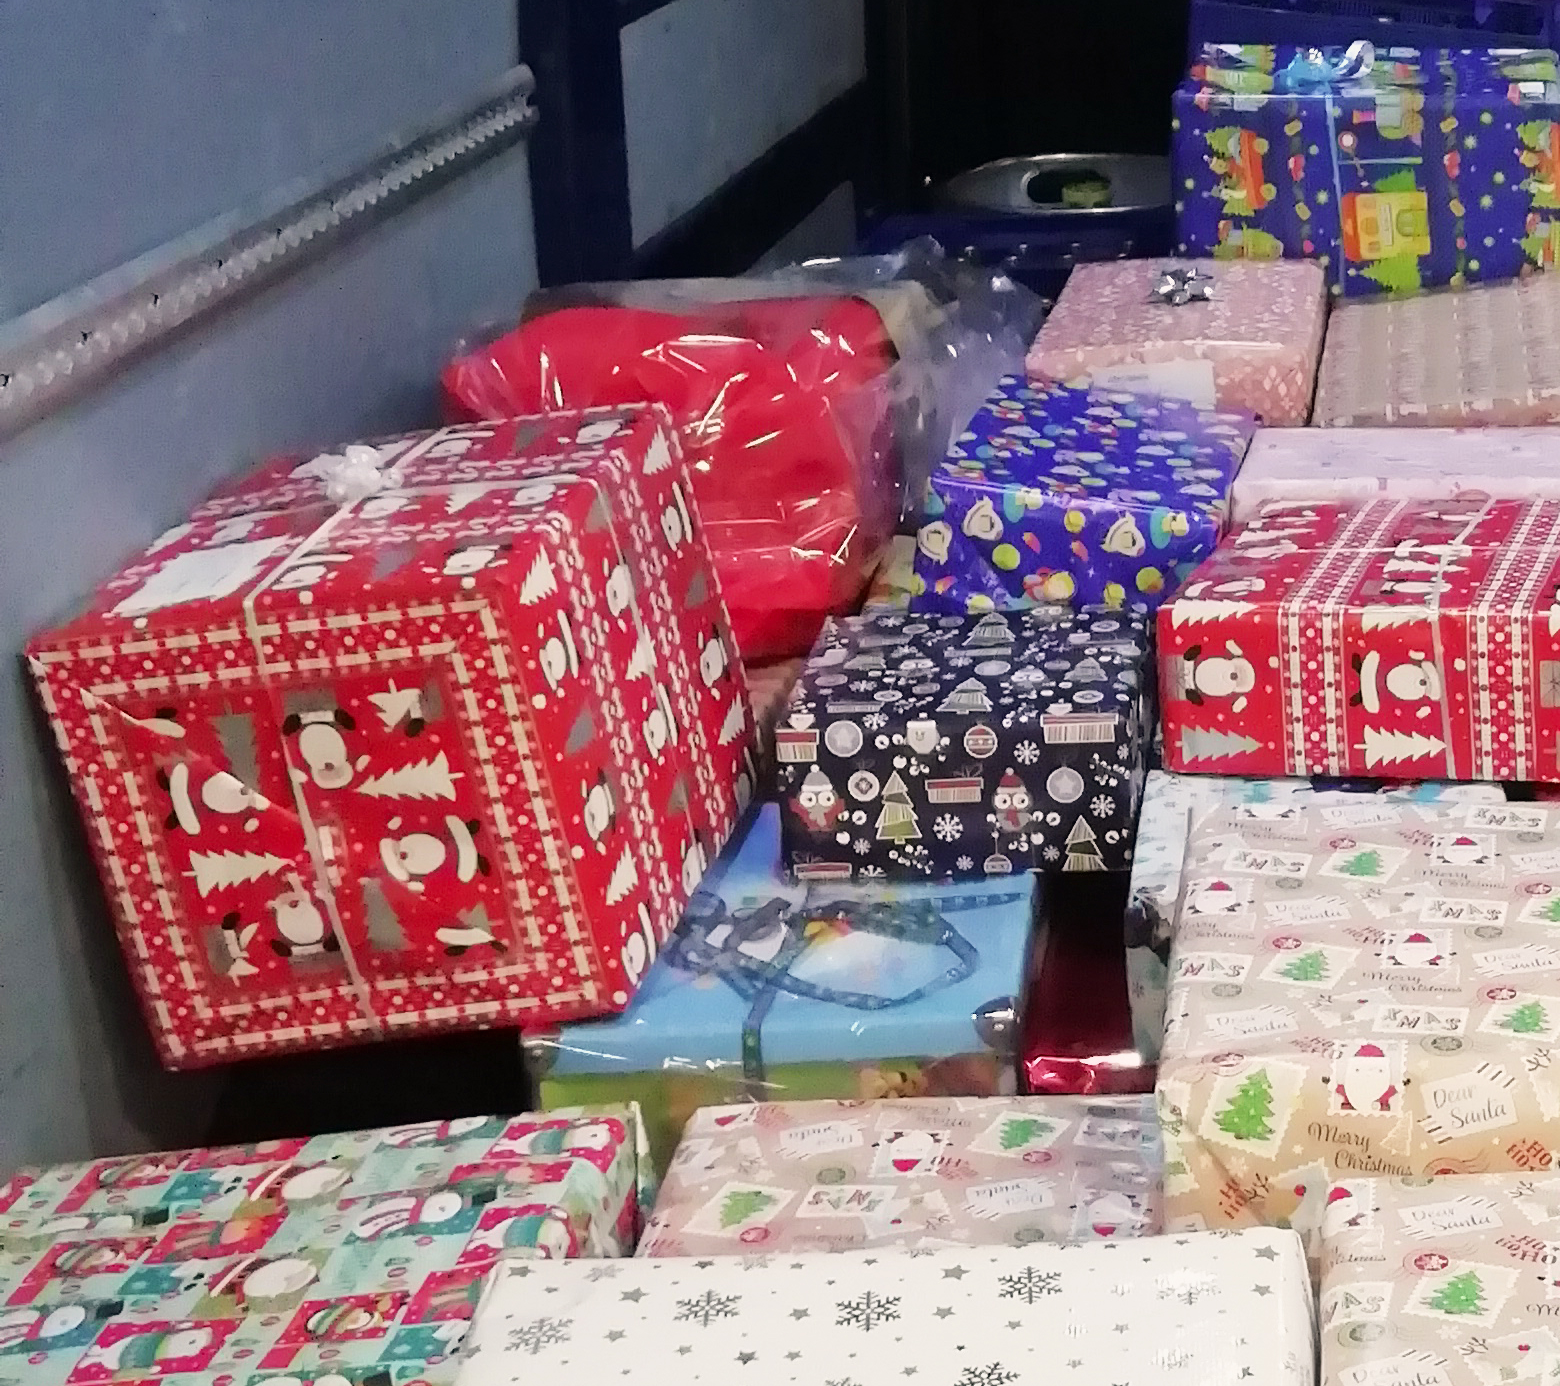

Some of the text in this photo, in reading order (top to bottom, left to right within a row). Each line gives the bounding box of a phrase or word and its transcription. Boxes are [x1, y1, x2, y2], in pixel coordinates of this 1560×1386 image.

[1433, 1082, 1477, 1109] Dear
[1450, 1098, 1508, 1129] Santa
[1308, 1122, 1370, 1153] Merry
[1334, 1149, 1413, 1175] Christmas
